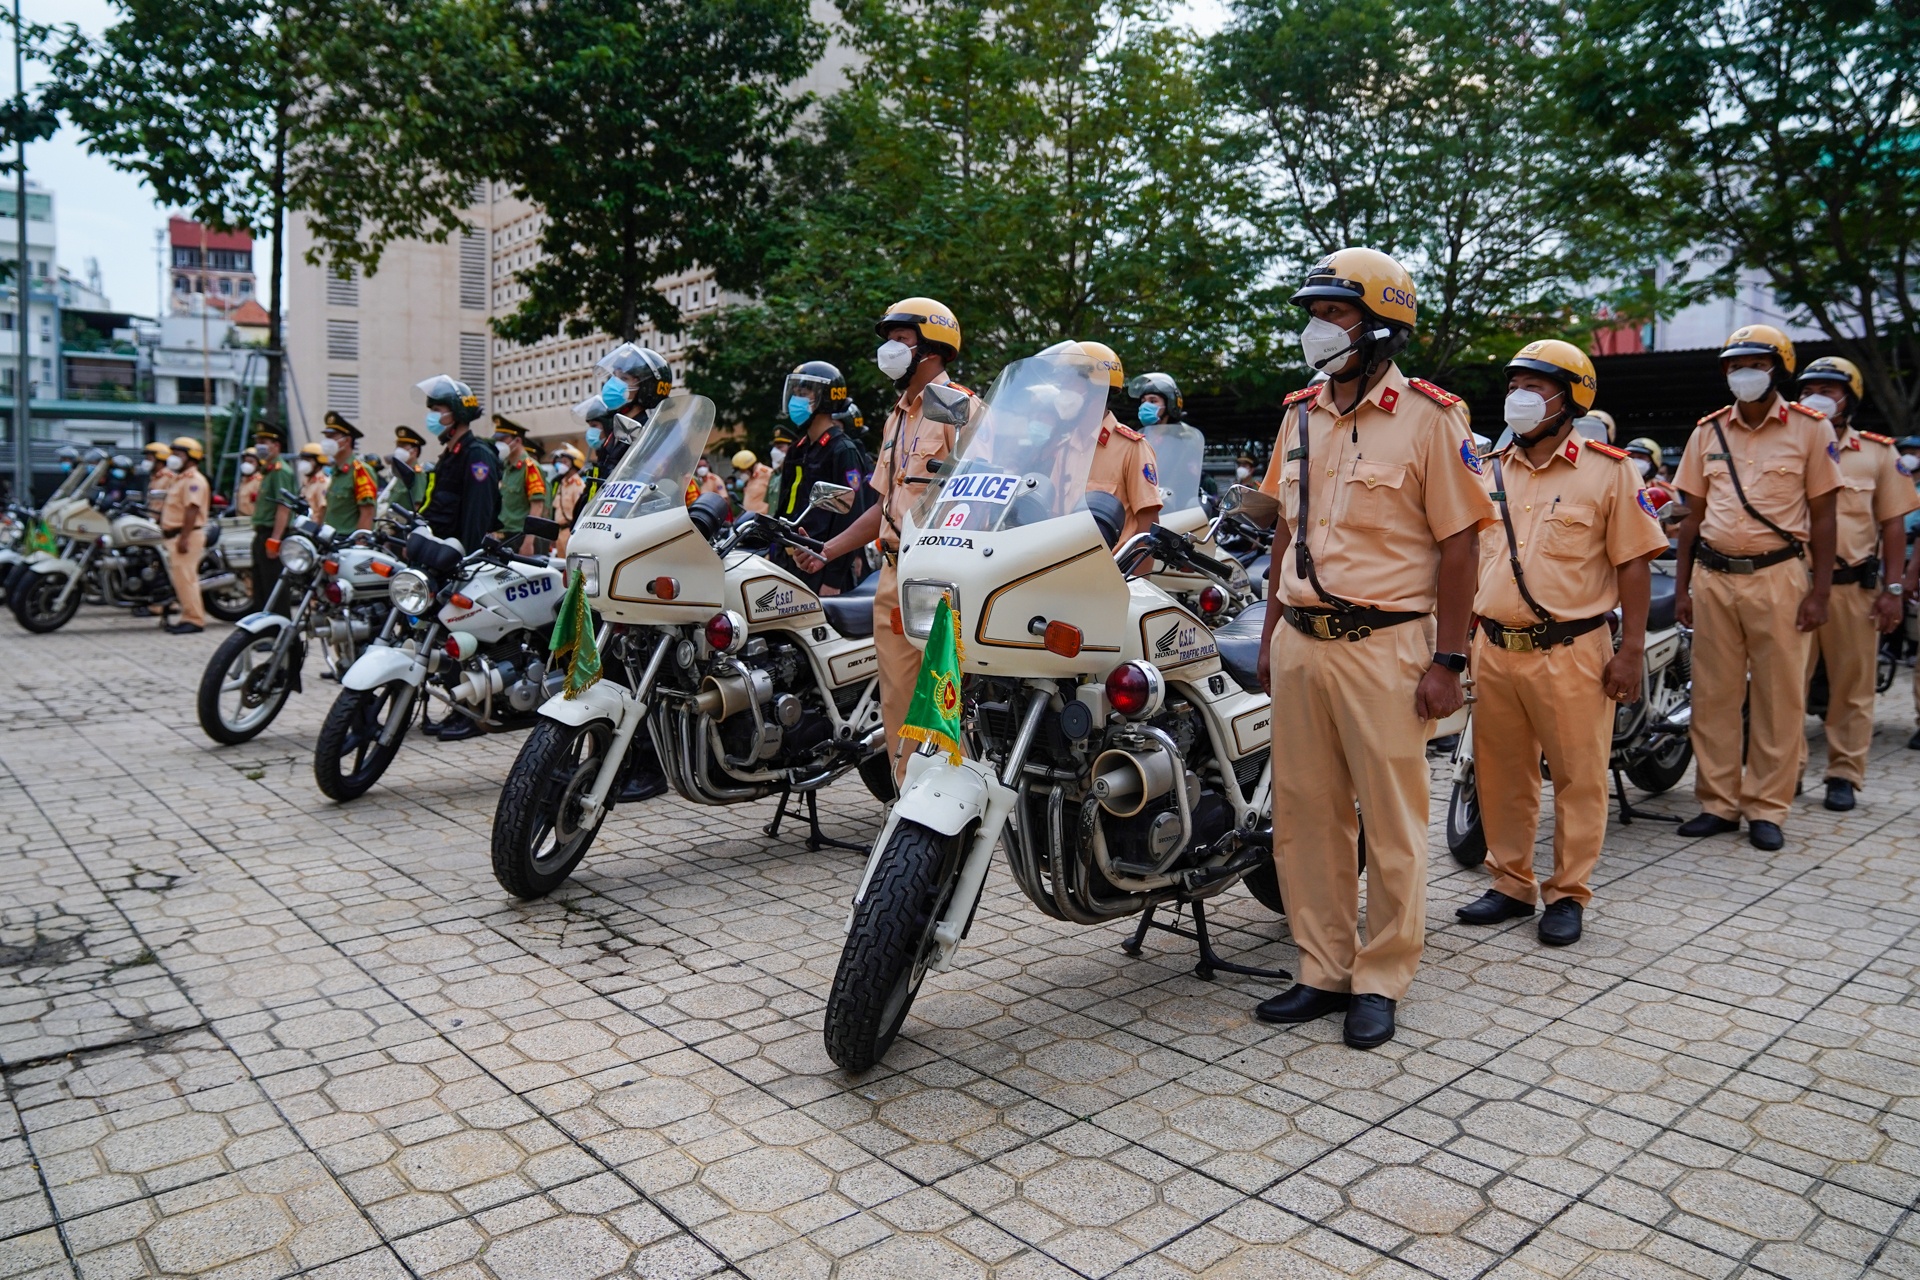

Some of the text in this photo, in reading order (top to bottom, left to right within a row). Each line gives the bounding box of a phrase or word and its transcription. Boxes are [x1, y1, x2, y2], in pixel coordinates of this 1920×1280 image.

[600, 481, 642, 501] POLICE
[940, 475, 1017, 500] POLICE
[600, 503, 613, 514] 18
[579, 521, 612, 532] HONDA
[945, 513, 965, 527] 19
[916, 535, 974, 550] HONDA
[755, 606, 779, 614] HONDA
[778, 601, 817, 616] TRAFFIC POLICE
[1154, 648, 1179, 659] HONDA
[1179, 643, 1215, 661] TRAFFIC POLICE
